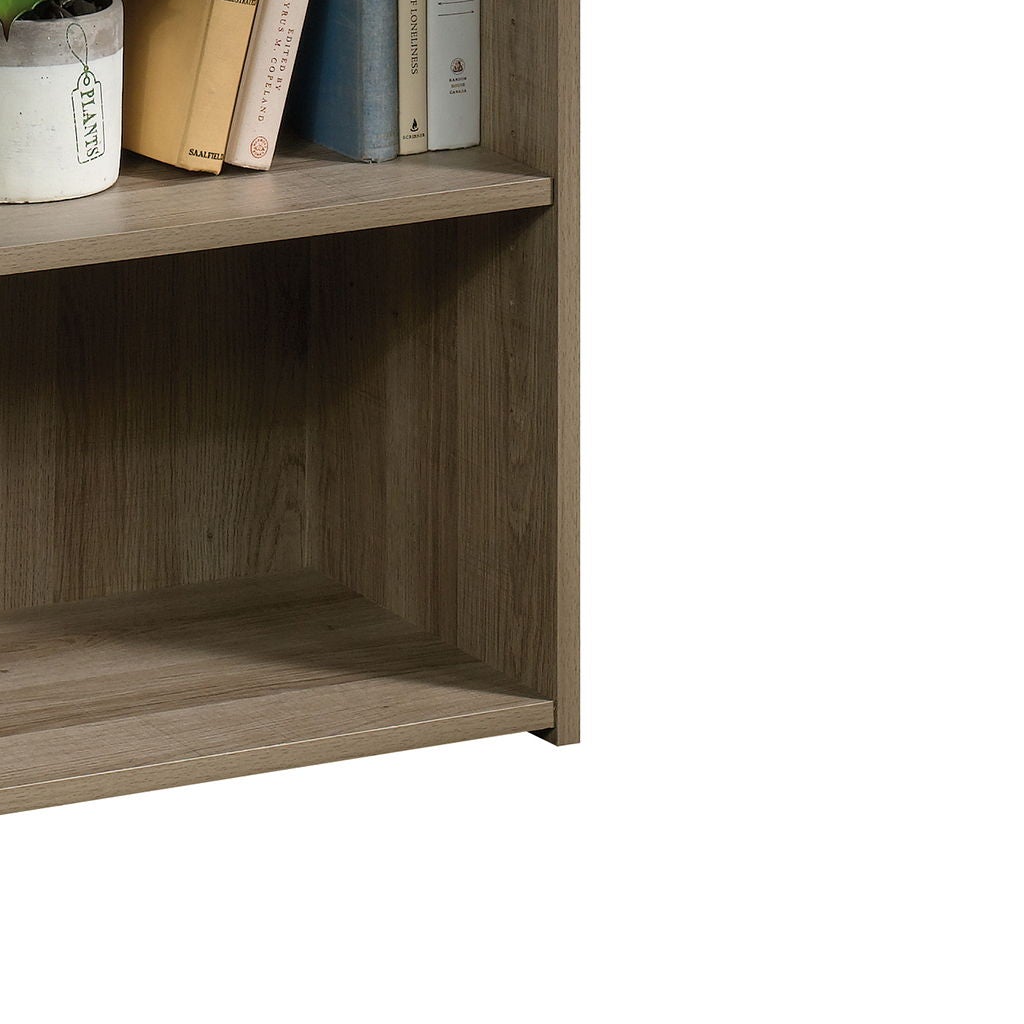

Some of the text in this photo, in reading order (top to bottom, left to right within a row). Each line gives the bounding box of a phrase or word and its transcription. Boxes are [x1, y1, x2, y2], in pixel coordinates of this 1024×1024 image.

[273, 38, 282, 51] M.
[279, 28, 294, 72] EDITED
[410, 9, 418, 75] LONELINESS
[258, 57, 278, 122] COPELAND
[80, 88, 99, 157] PLANTS
